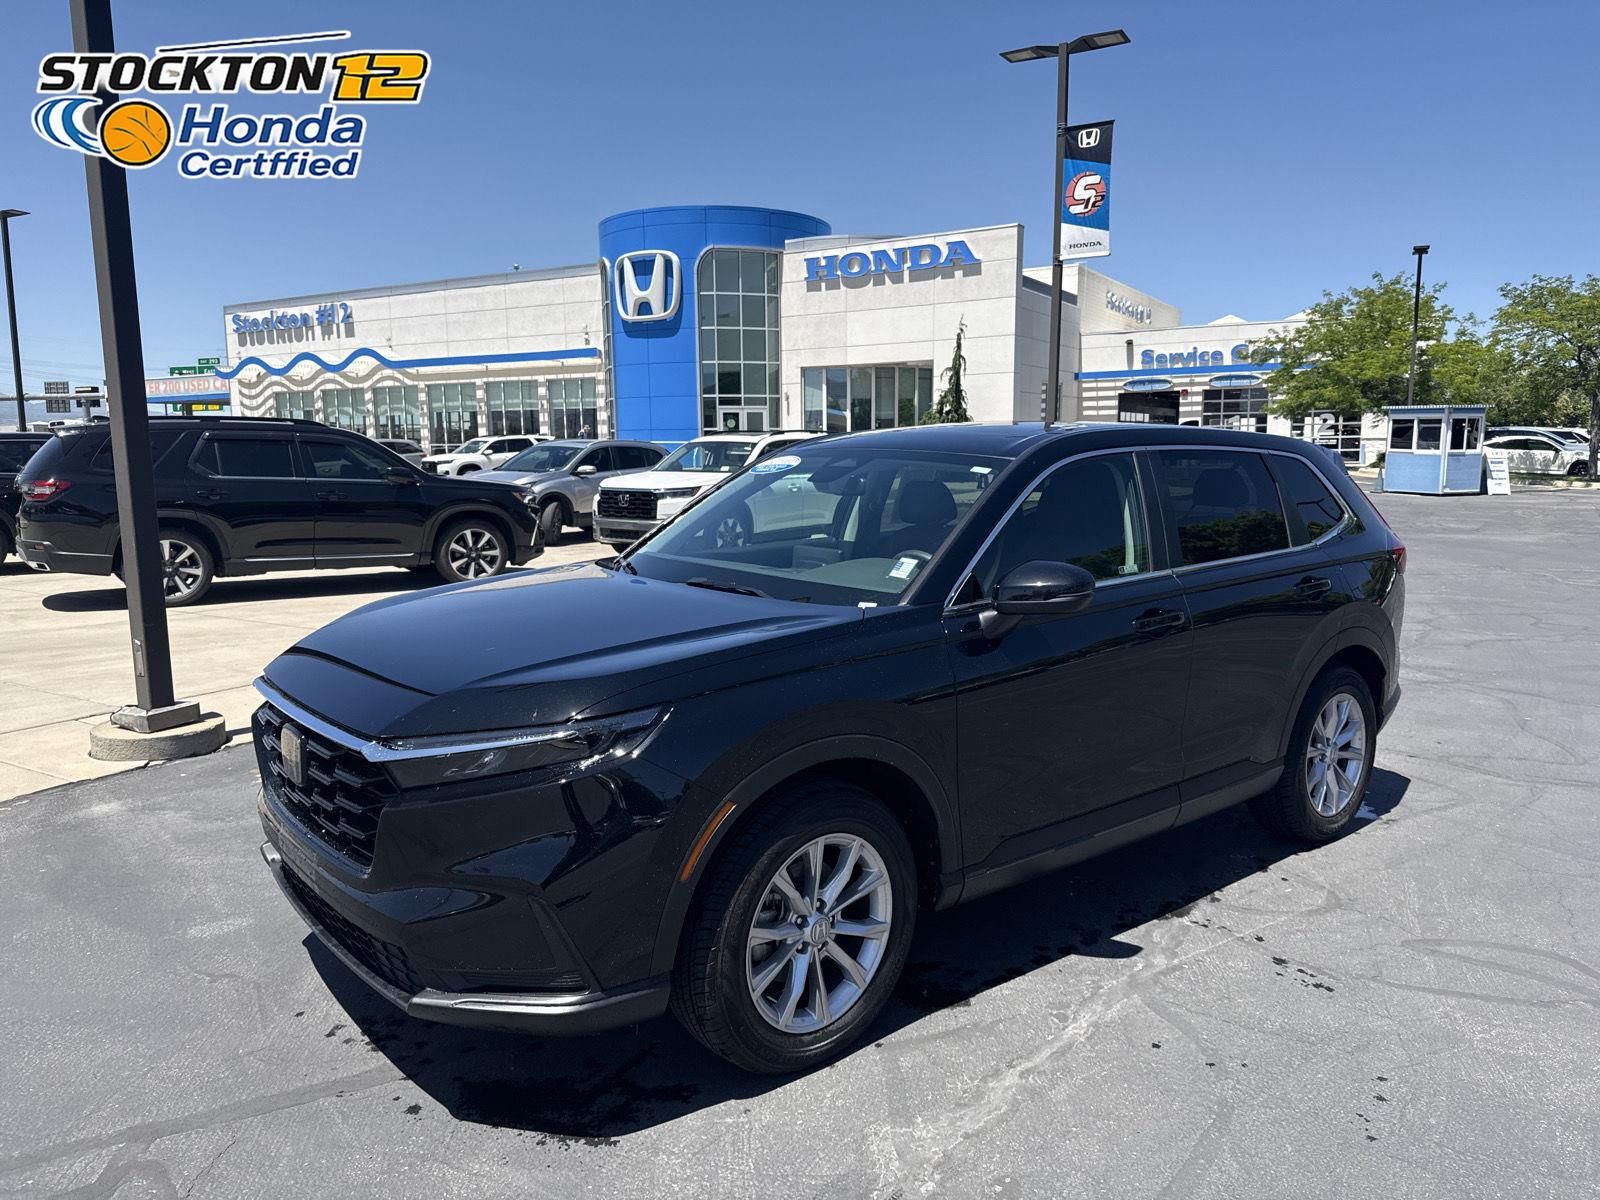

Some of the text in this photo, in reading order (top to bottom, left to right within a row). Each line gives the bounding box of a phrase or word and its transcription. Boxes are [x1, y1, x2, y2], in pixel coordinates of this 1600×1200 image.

[1068, 241, 1103, 250] HONDA
[804, 240, 982, 281] HONDA
[232, 303, 349, 333] Stockton #12
[1141, 346, 1224, 365] Service
[163, 380, 181, 393] 200
[184, 378, 210, 392] USED
[1318, 413, 1336, 436] 2
